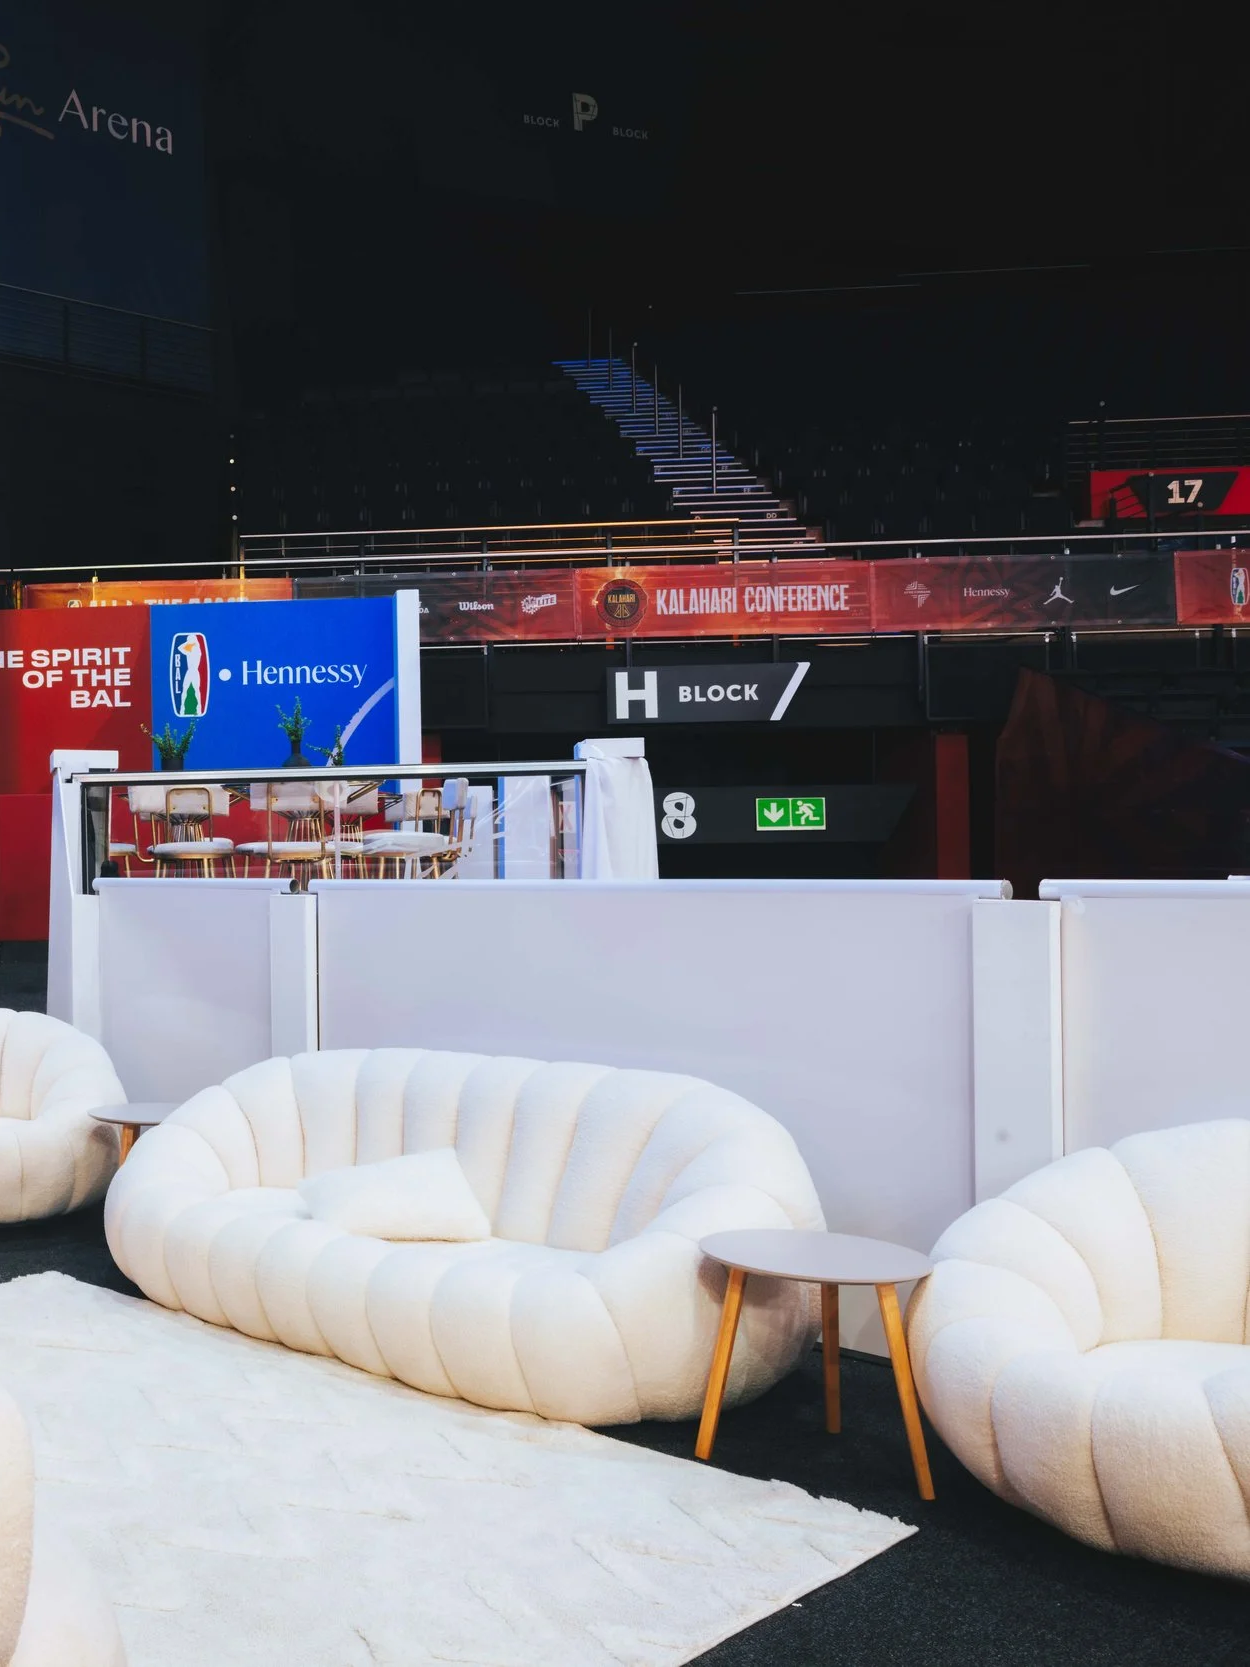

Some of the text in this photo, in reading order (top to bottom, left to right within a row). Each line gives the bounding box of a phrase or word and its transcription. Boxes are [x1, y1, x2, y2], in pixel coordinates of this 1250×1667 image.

[58, 88, 174, 155] Arena
[523, 91, 649, 140] BLOCK P BLOCK
[1166, 479, 1203, 504] 17
[607, 593, 636, 603] KALAHARI
[656, 584, 850, 615] KALAHARI CONFERENCE
[963, 587, 1010, 598] Hennessy
[458, 601, 494, 611] Wilson
[31, 646, 131, 669] SPIRIT
[22, 668, 131, 689] OF THE
[174, 653, 182, 694] BAL
[242, 660, 368, 688] Hennessy
[70, 689, 131, 709] BAL
[615, 670, 759, 720] H BLOCK
[661, 791, 697, 839] 8
